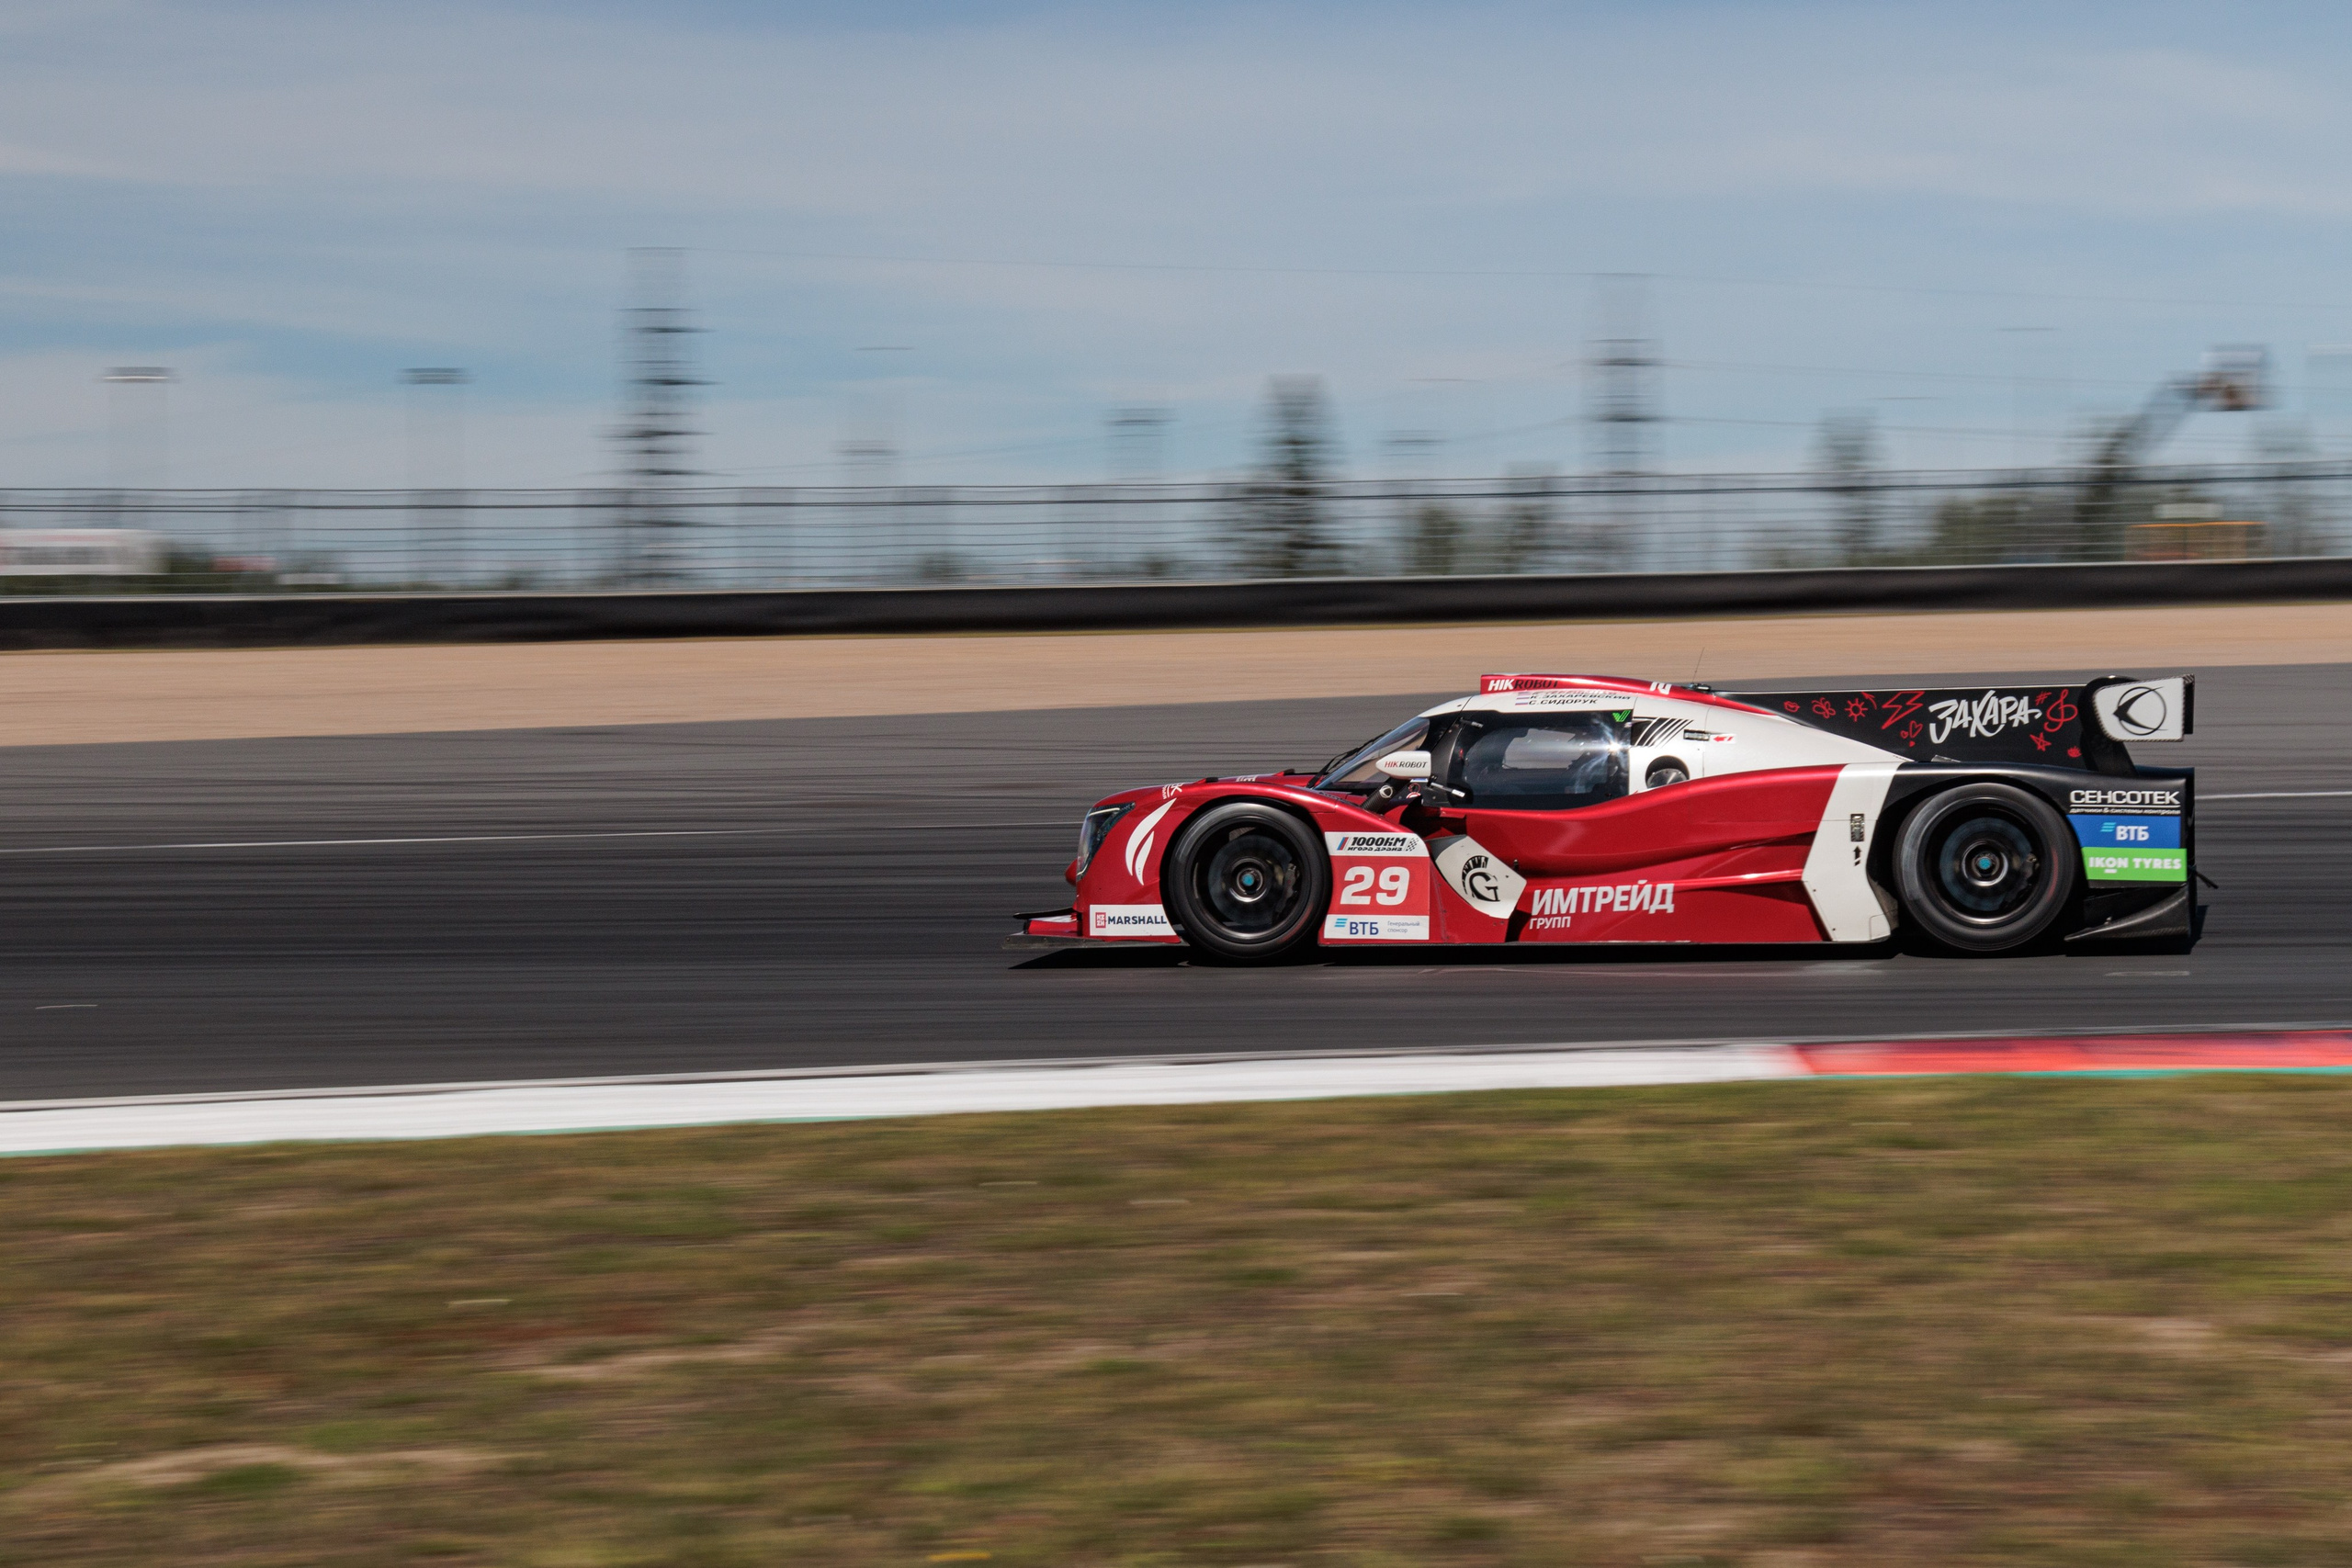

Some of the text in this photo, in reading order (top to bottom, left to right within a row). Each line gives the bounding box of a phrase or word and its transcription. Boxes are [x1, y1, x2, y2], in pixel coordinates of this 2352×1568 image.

[1487, 679, 1558, 692] HIKROBOT
[1928, 690, 2042, 744] ЗАХАРА
[2069, 790, 2181, 805] СЕНСОТЕК
[2116, 825, 2150, 841] ВТБ
[2088, 856, 2183, 872] IKON TYRES
[1340, 865, 1410, 906] 29
[1531, 879, 1675, 916] ИМТРЕЙД
[1107, 916, 1168, 925] MARSHALL
[1529, 916, 1572, 930] ГРУПП
[1349, 921, 1380, 936] ВТБ
